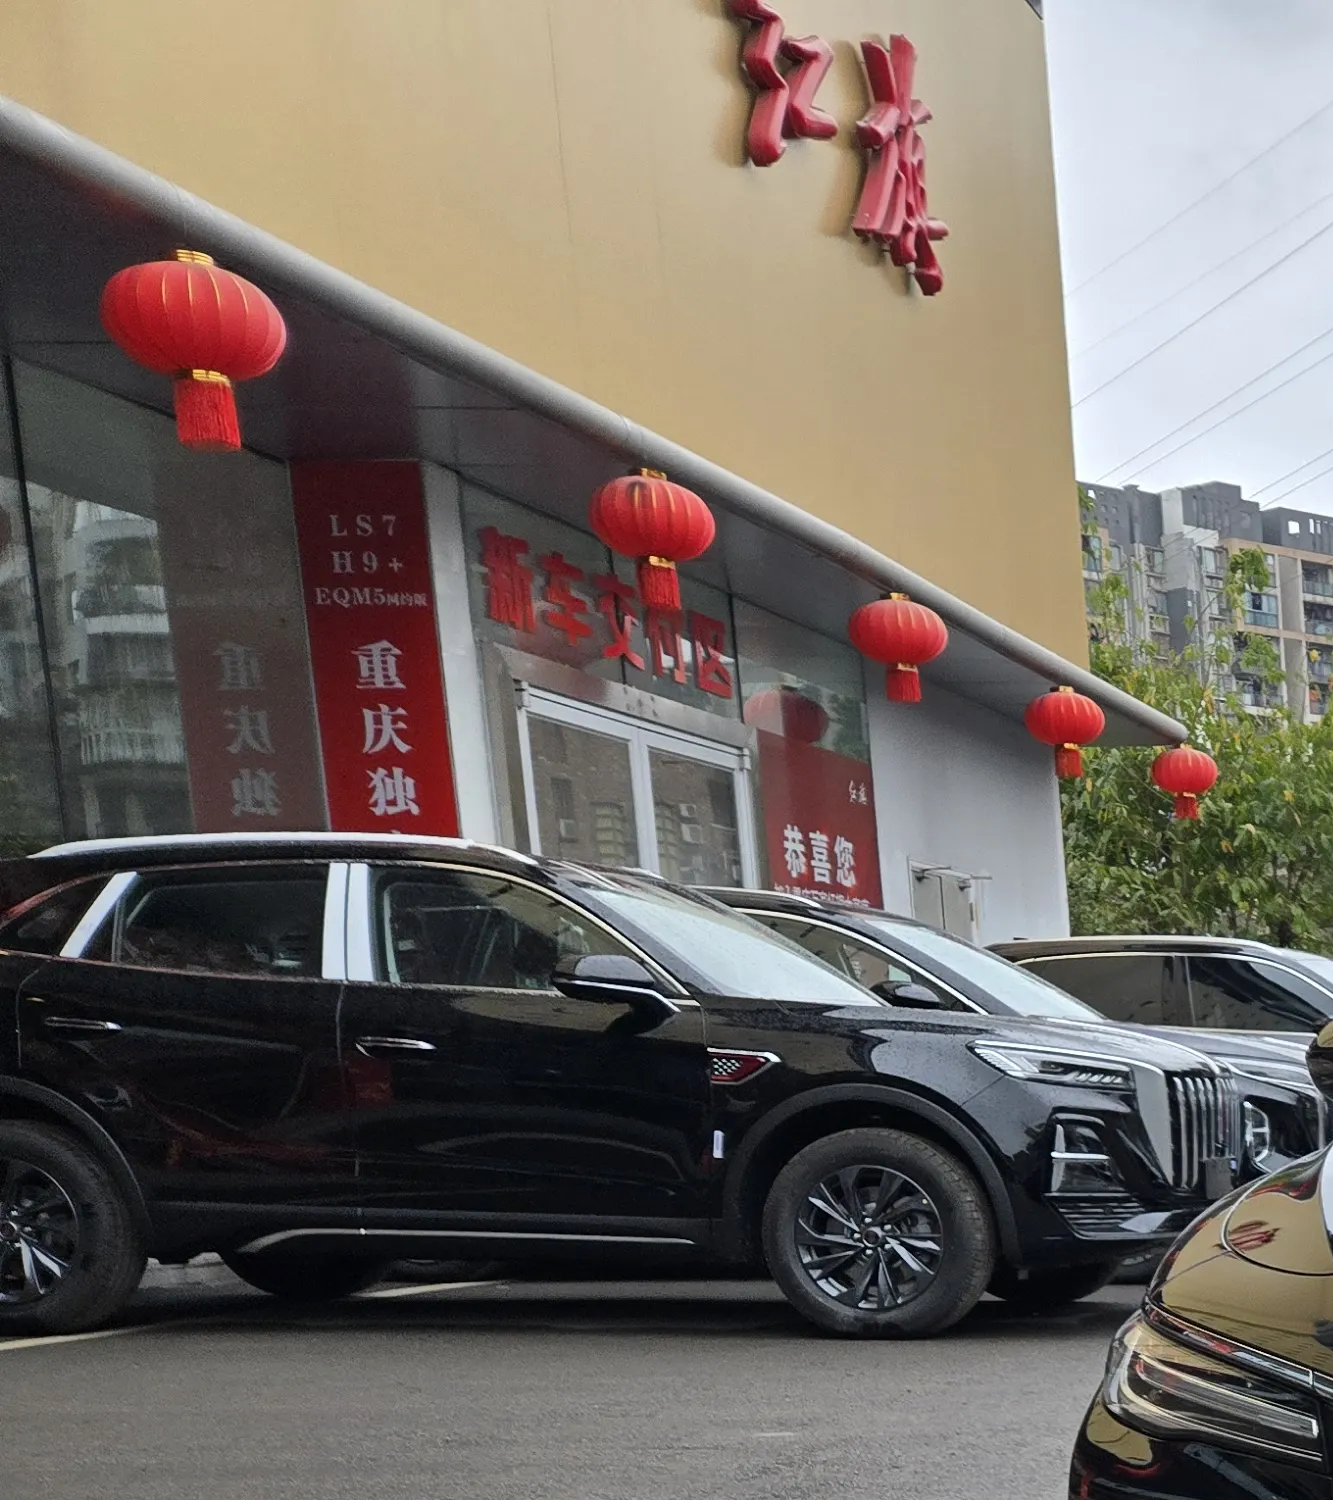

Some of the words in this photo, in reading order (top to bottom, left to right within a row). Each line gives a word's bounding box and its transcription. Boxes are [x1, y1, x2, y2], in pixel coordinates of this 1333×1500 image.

[328, 514, 397, 537] LS7
[331, 550, 403, 574] H9+
[351, 639, 421, 833] 重庆独
[783, 823, 857, 888] 恭喜您
